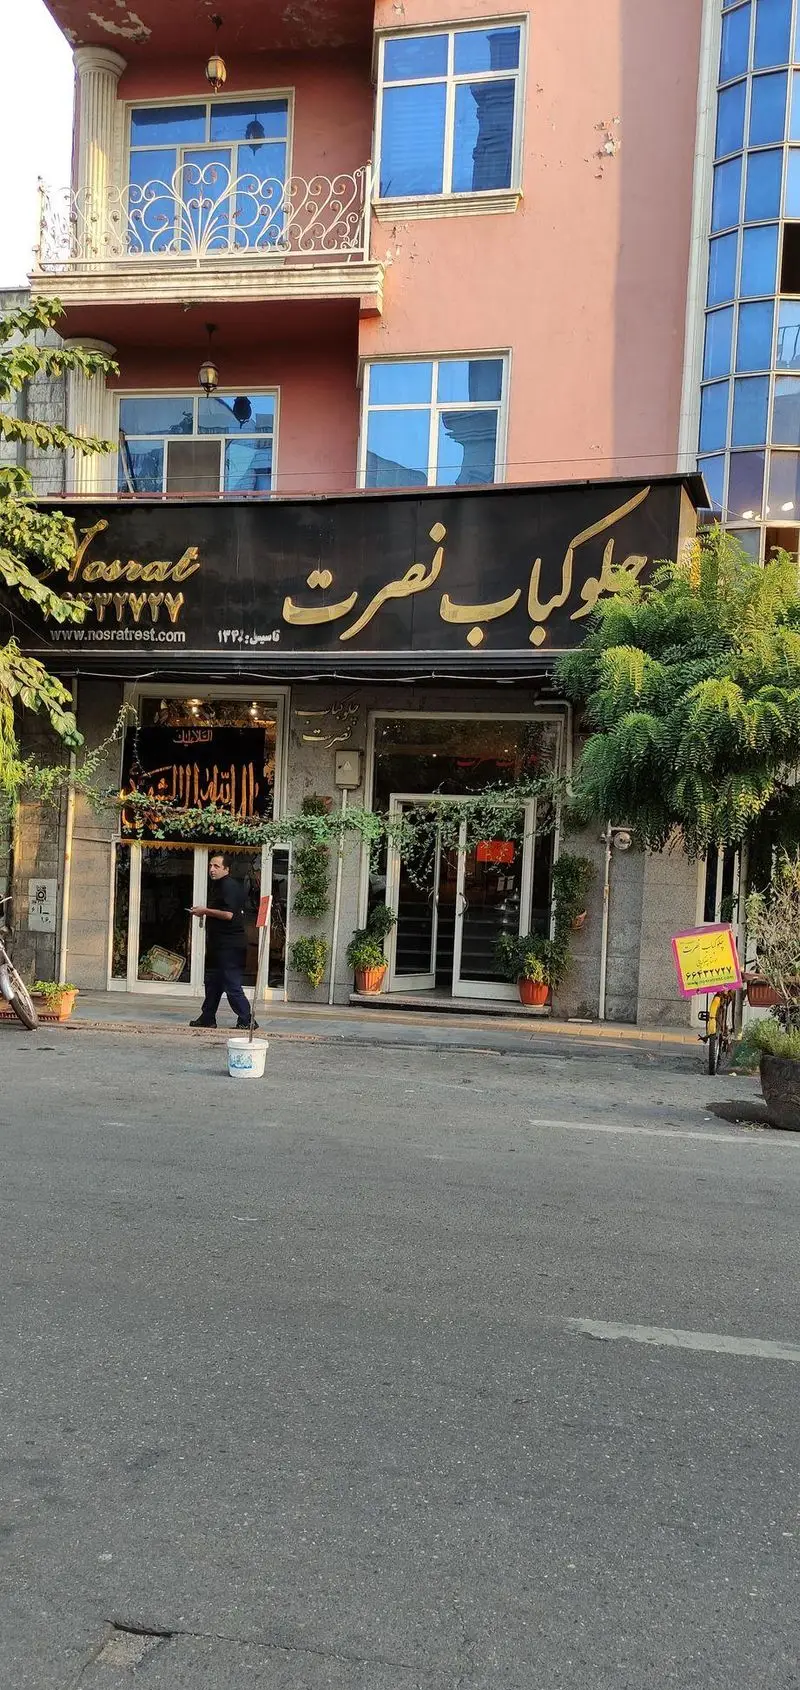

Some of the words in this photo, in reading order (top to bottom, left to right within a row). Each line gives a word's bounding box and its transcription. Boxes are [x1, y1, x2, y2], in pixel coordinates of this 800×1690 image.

[282, 522, 447, 641] نصرت
[49, 627, 187, 644] www.nosratrest.com
[302, 726, 353, 749] نصرت
